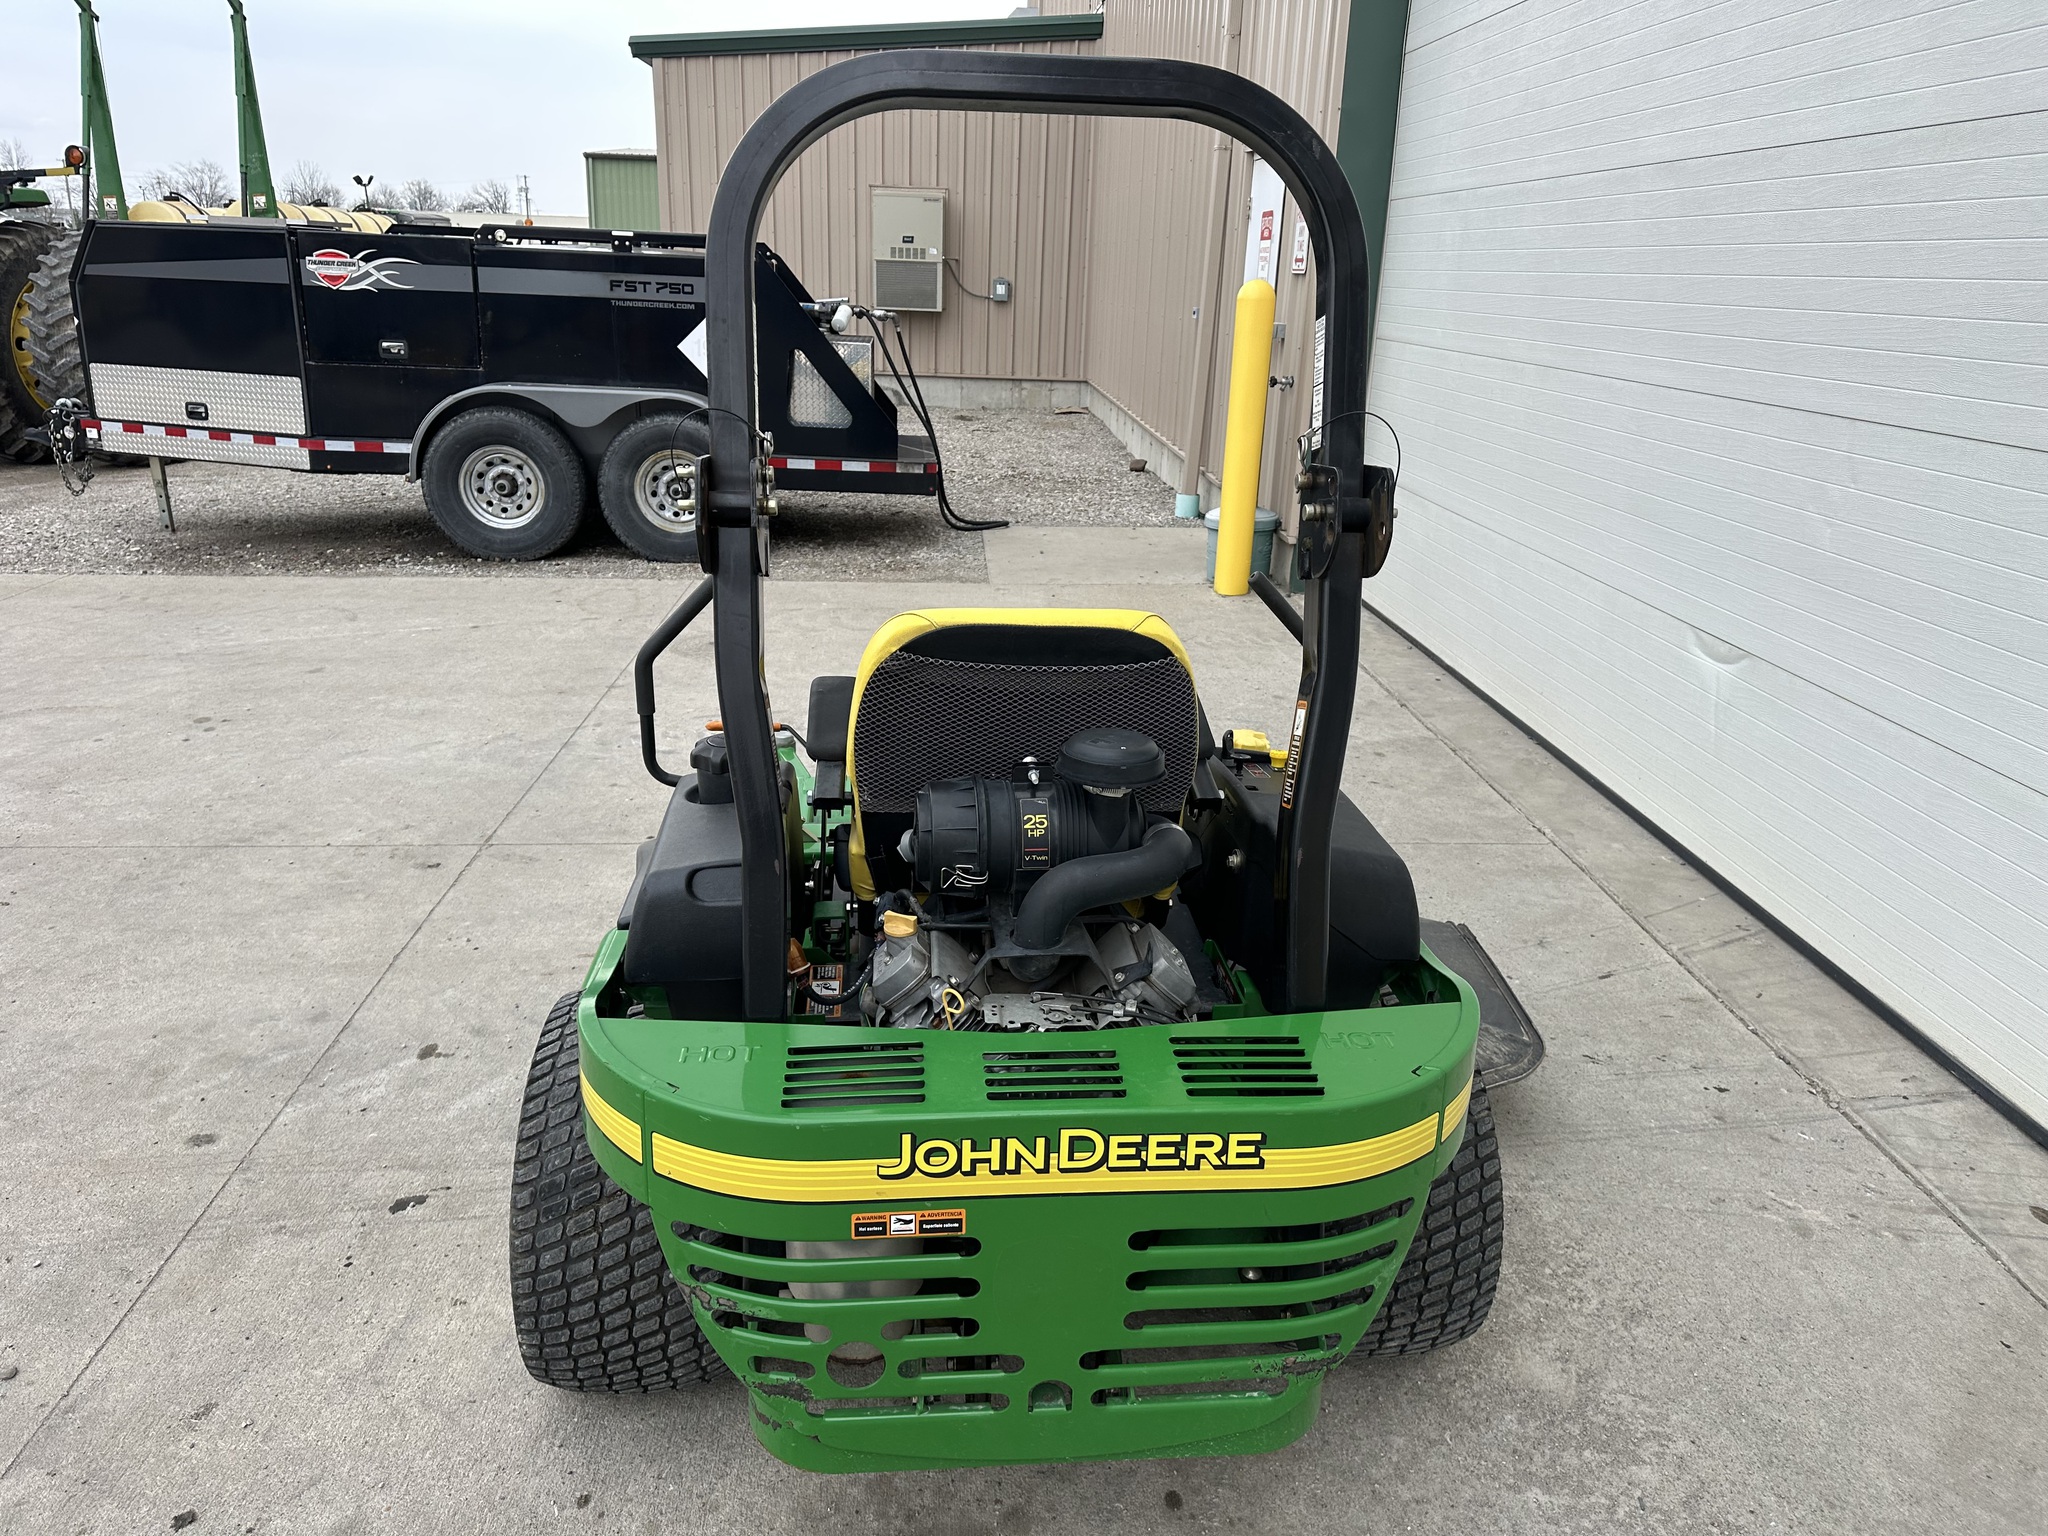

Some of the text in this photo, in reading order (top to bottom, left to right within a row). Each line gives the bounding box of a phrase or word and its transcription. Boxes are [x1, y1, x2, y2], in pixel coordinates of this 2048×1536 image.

[307, 259, 336, 267] THUNDER
[609, 280, 695, 296] FST 750
[611, 300, 695, 310] THUNDERCREEK.COM
[1023, 814, 1048, 829] 25
[1027, 829, 1045, 838] HP
[1320, 1031, 1395, 1050] HOT
[678, 1045, 763, 1063] HOT
[877, 1127, 1266, 1180] JOHN DEERE
